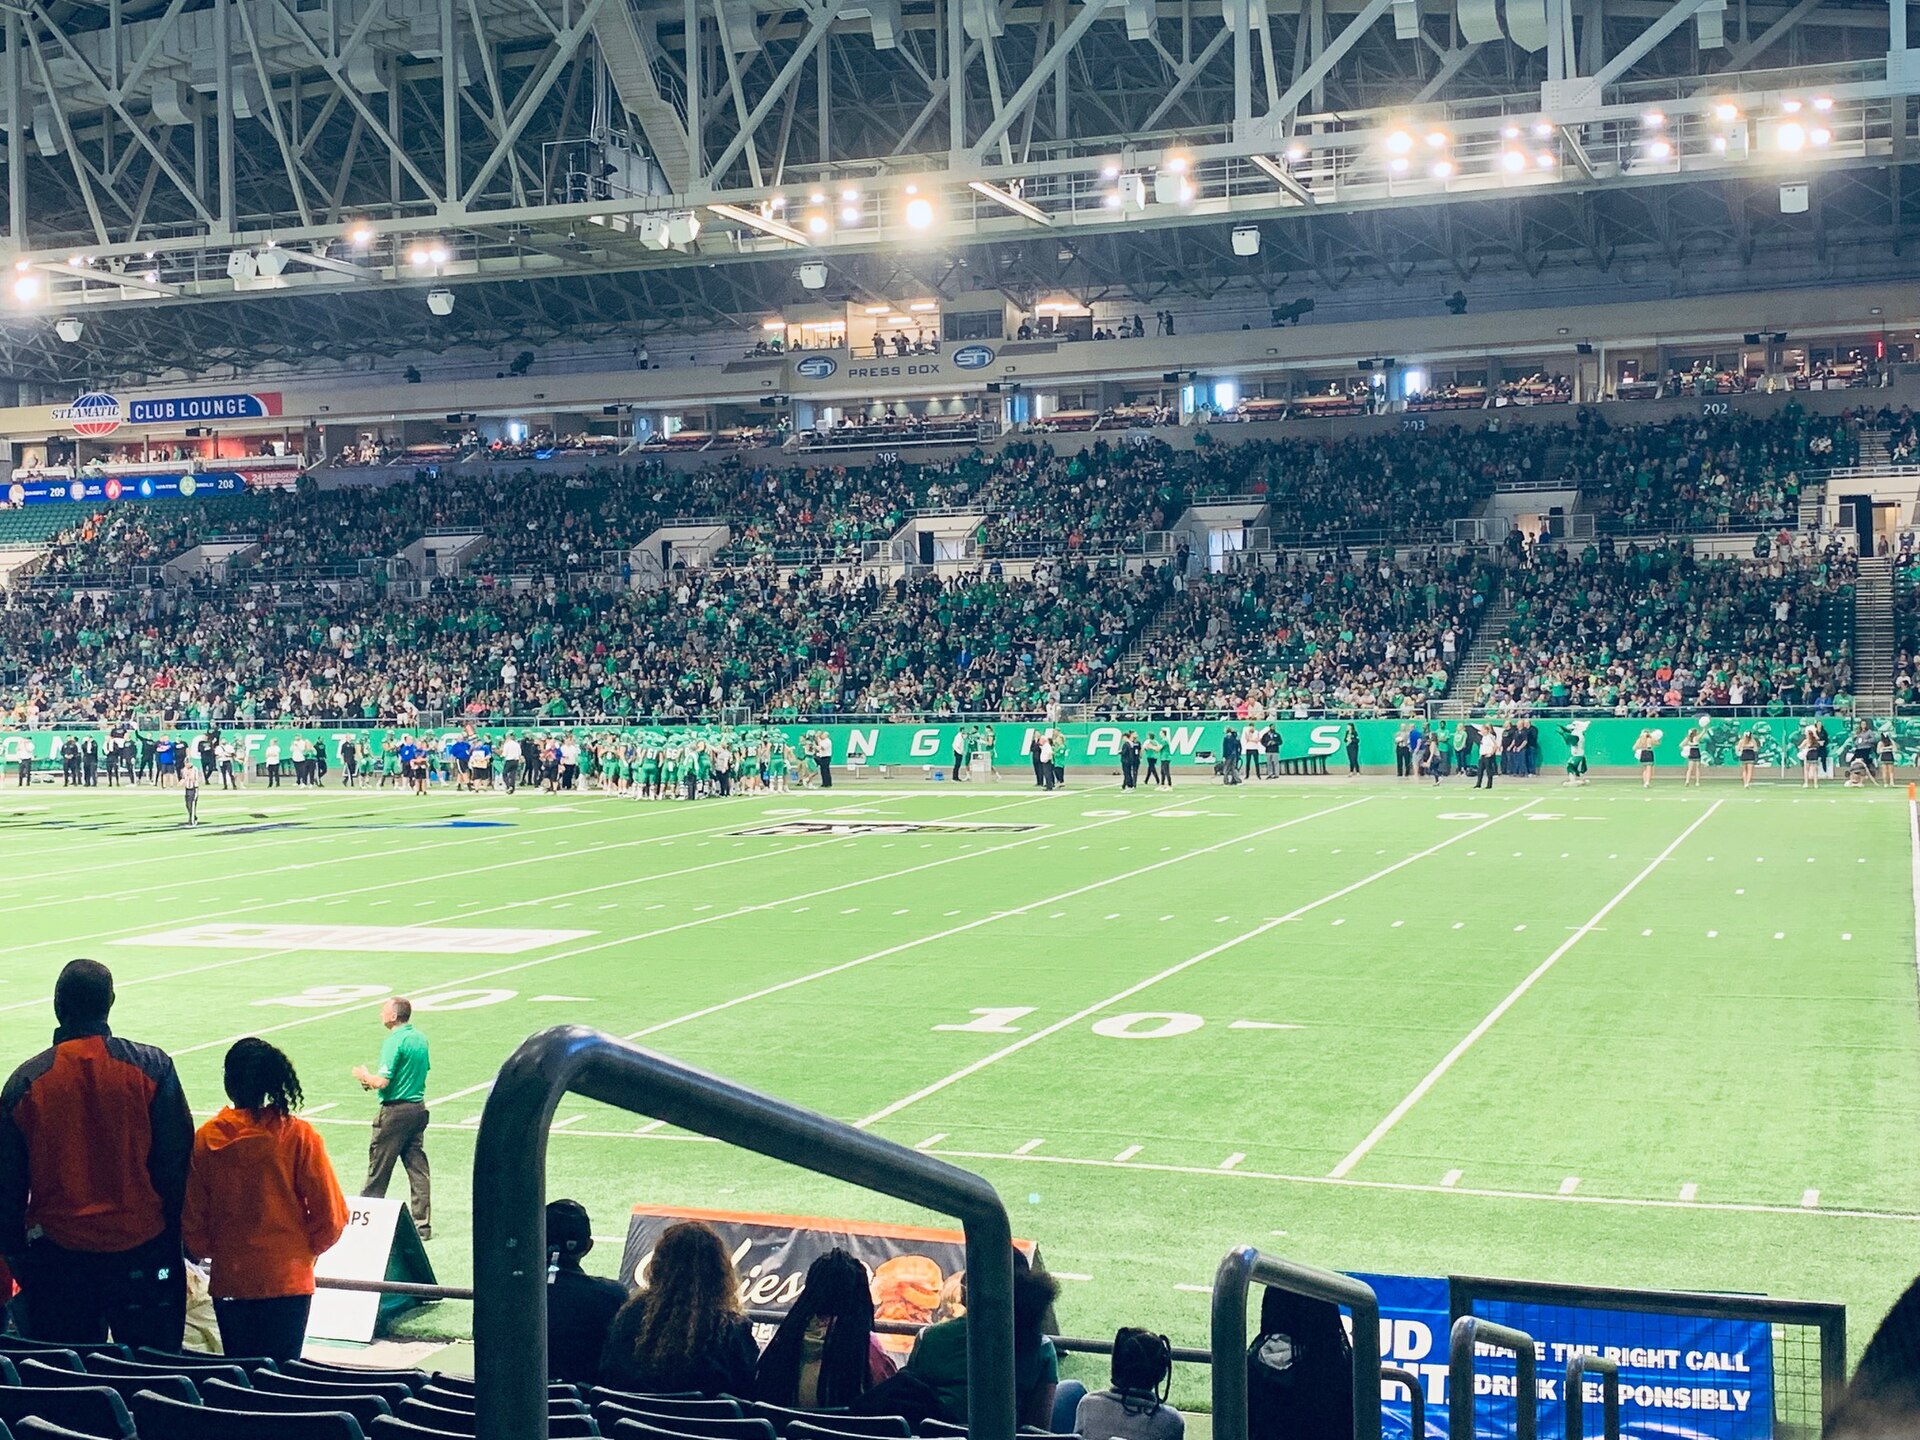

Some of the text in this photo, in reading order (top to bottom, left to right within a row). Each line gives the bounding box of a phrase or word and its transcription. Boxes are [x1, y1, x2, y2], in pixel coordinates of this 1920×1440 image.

[848, 364, 940, 378] PRESS BOX
[51, 404, 120, 420] STEAMATIC
[134, 398, 247, 420] CLUB LOUNGE
[1703, 402, 1728, 415] 202
[49, 487, 66, 498] 209
[217, 479, 235, 490] 208
[930, 1006, 1205, 1039] 10
[1474, 1341, 1751, 1373] MAE THE RIGHT CALL
[1473, 1373, 1751, 1412] DRIK EPONSIBLY
